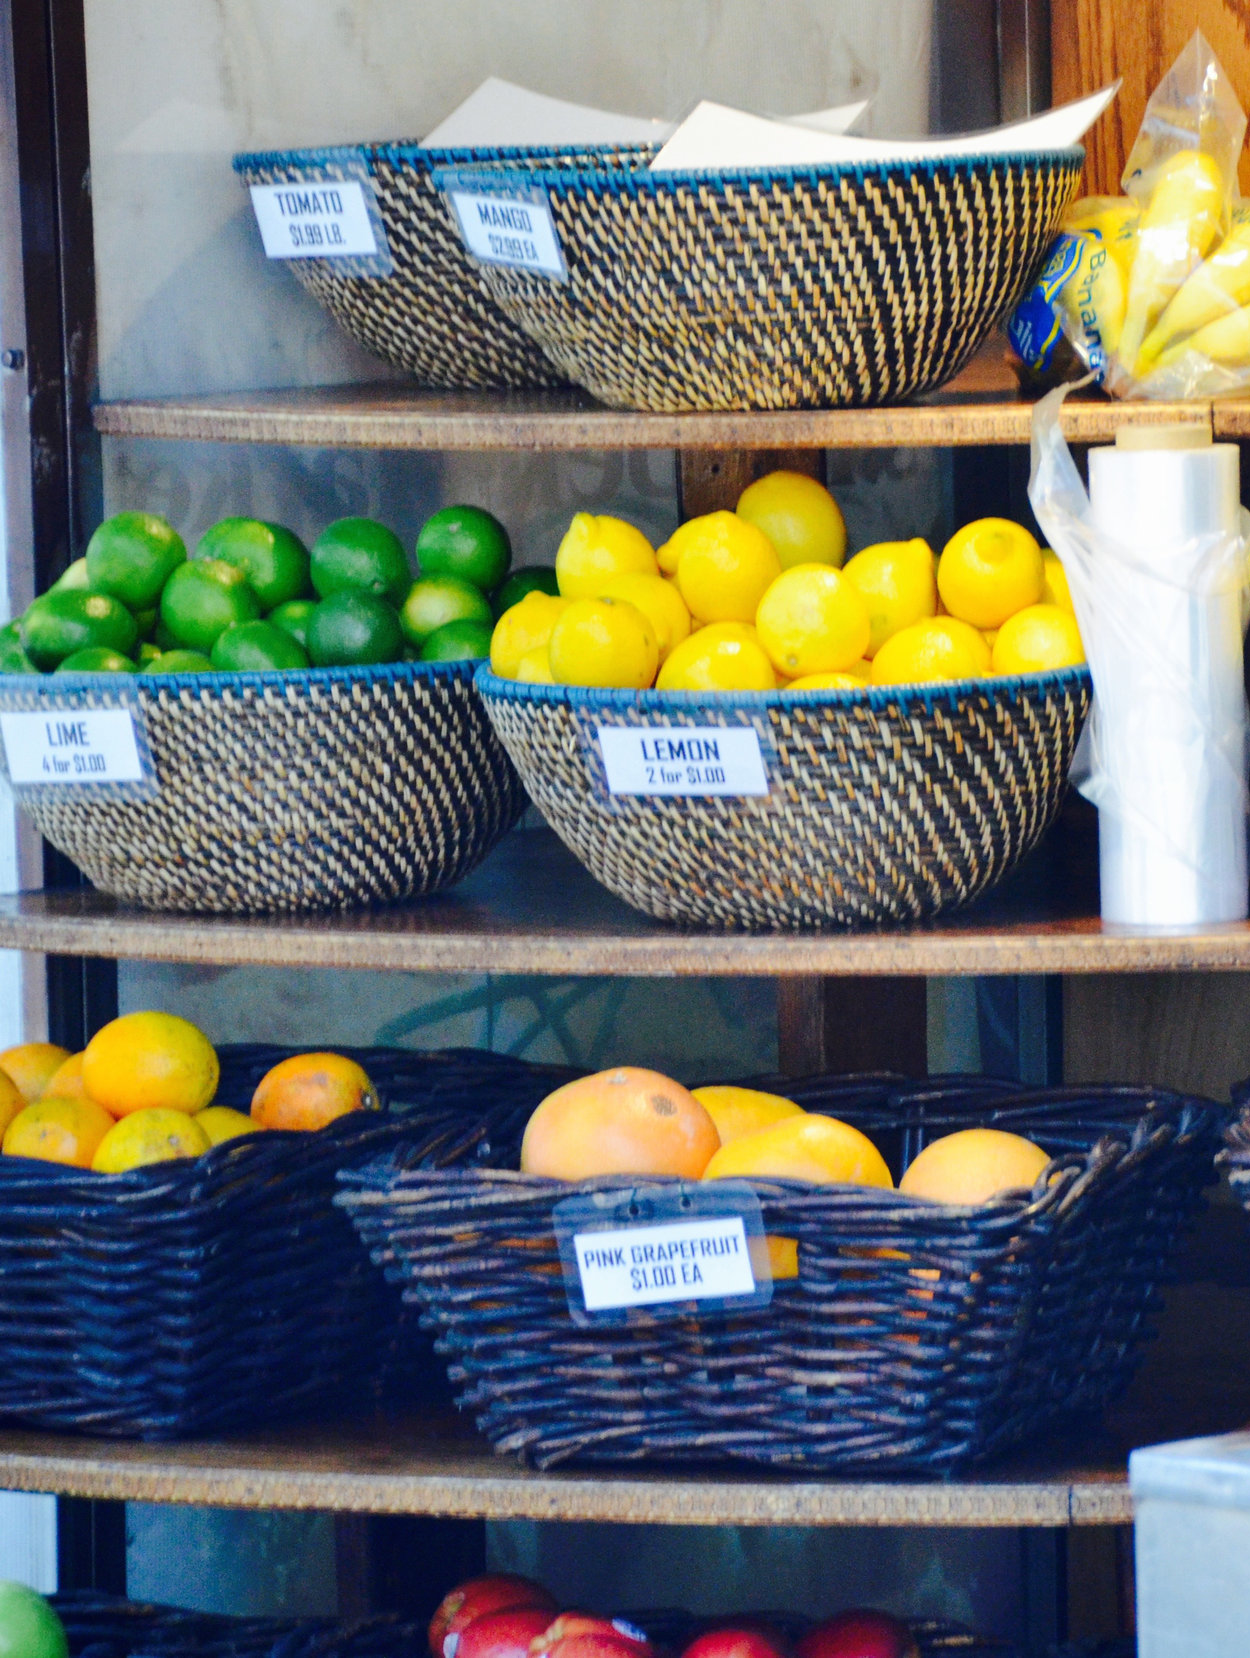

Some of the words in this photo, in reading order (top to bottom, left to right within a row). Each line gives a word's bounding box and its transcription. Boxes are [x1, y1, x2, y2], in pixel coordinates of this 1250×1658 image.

[273, 190, 344, 216] TOMATO
[476, 202, 534, 234] MANGO
[288, 222, 323, 248] $1.99
[523, 239, 540, 262] EA
[45, 721, 91, 747] LIME
[640, 738, 721, 761] LEMON
[42, 754, 50, 773] 4
[52, 754, 70, 773] for
[73, 753, 106, 774] $1.00
[645, 767, 656, 784] 2
[660, 766, 683, 784] for
[686, 766, 726, 785] $1.00
[584, 1248, 627, 1270] PINK
[630, 1234, 741, 1264] GRAPEFRUIT
[630, 1265, 676, 1291] $1.00
[680, 1264, 704, 1286] EA
